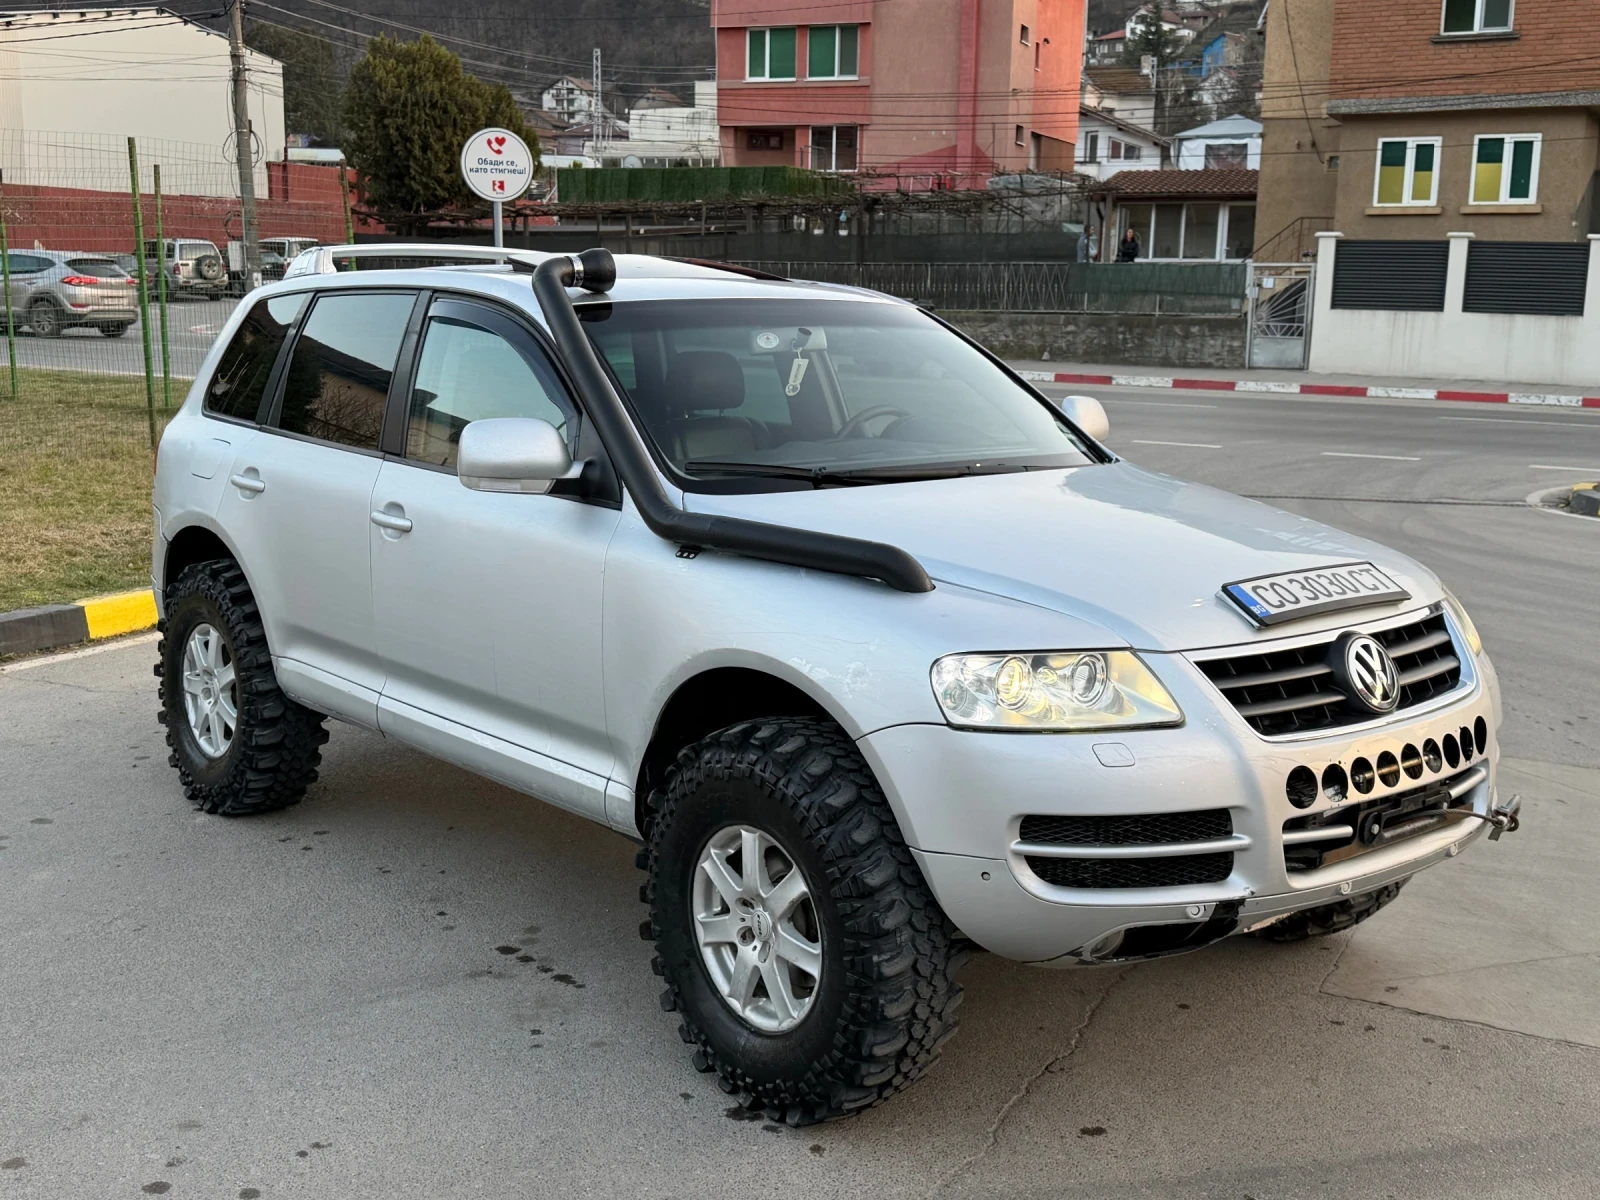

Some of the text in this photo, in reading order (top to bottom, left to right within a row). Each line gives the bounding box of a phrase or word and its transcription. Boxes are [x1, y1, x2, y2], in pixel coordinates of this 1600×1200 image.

[478, 157, 518, 168] Обади се,
[1287, 571, 1361, 601] 3030
[1250, 604, 1267, 614] BG
